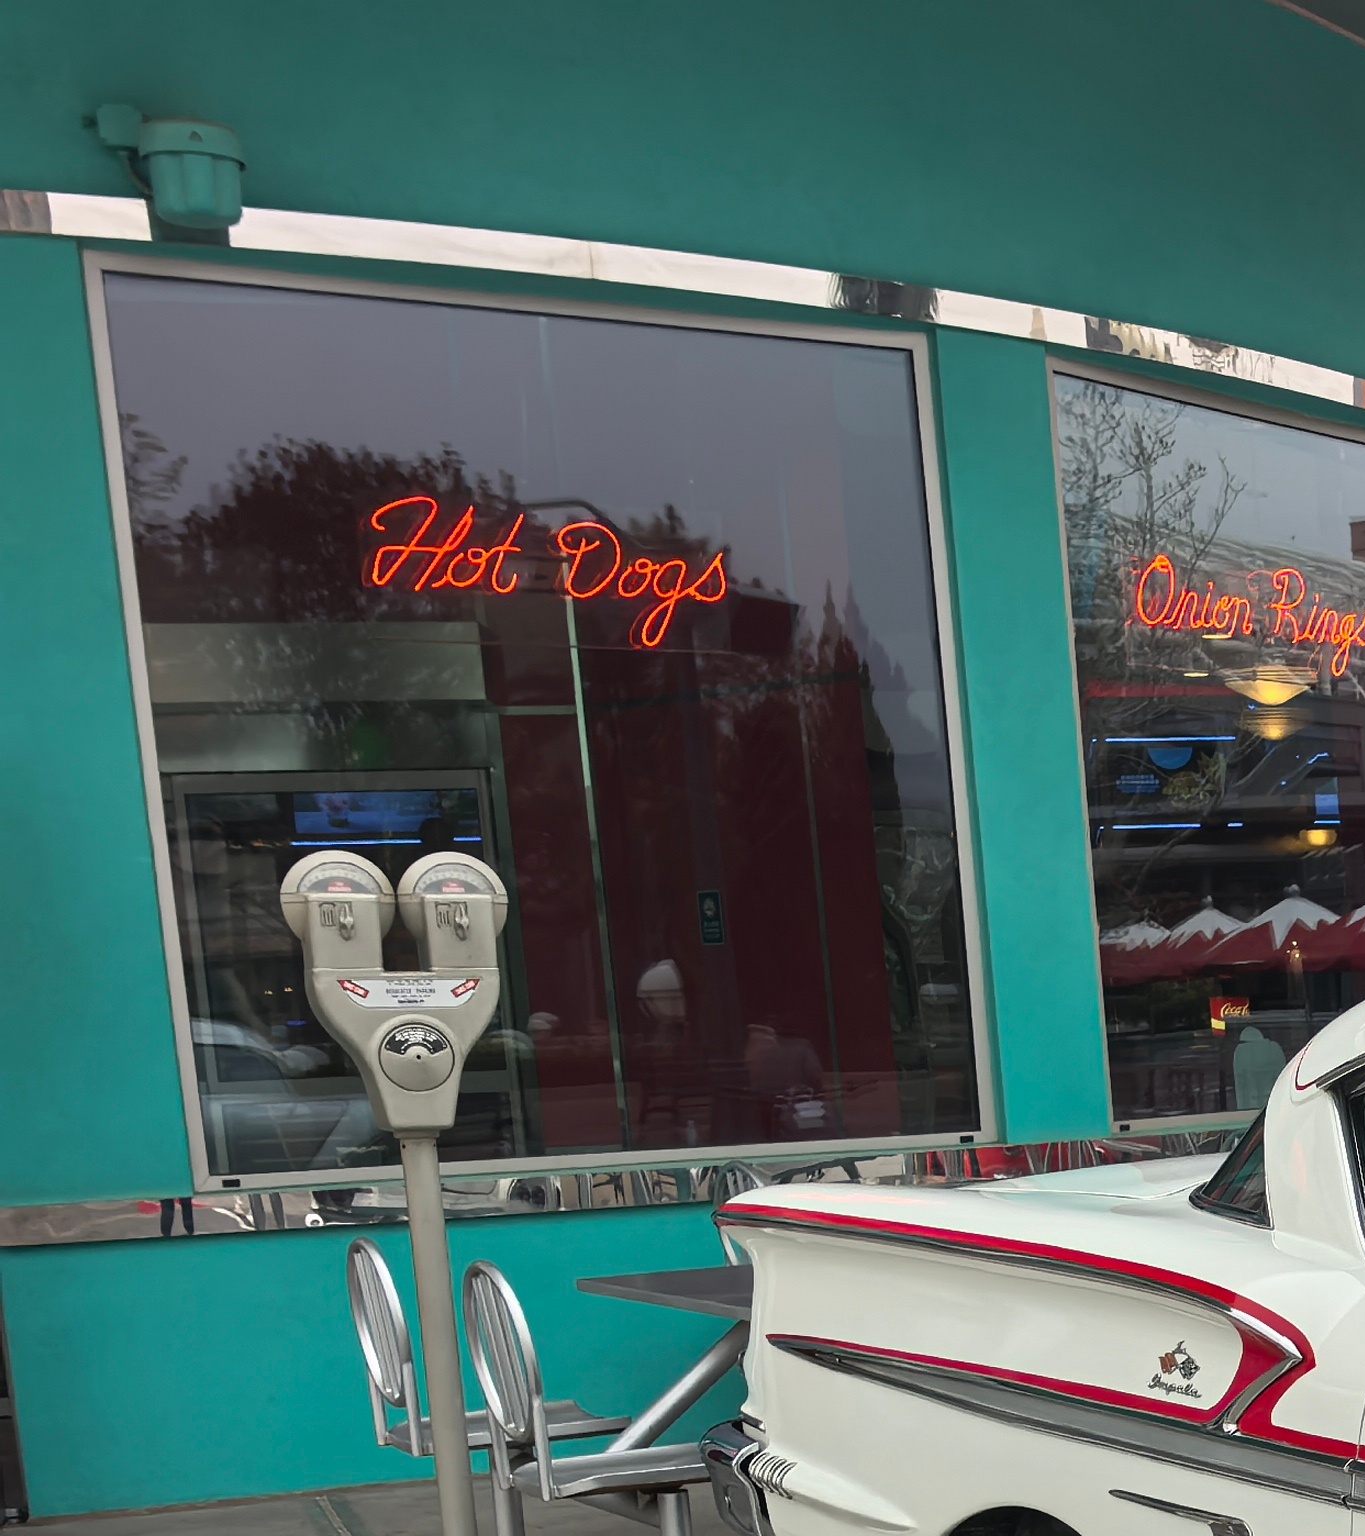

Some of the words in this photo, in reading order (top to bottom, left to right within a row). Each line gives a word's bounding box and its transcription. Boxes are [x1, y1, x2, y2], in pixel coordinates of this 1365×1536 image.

[371, 495, 524, 593] Hot
[557, 521, 728, 648] Dogs
[1136, 553, 1252, 635] Onion
[1147, 1373, 1202, 1398] Impala
